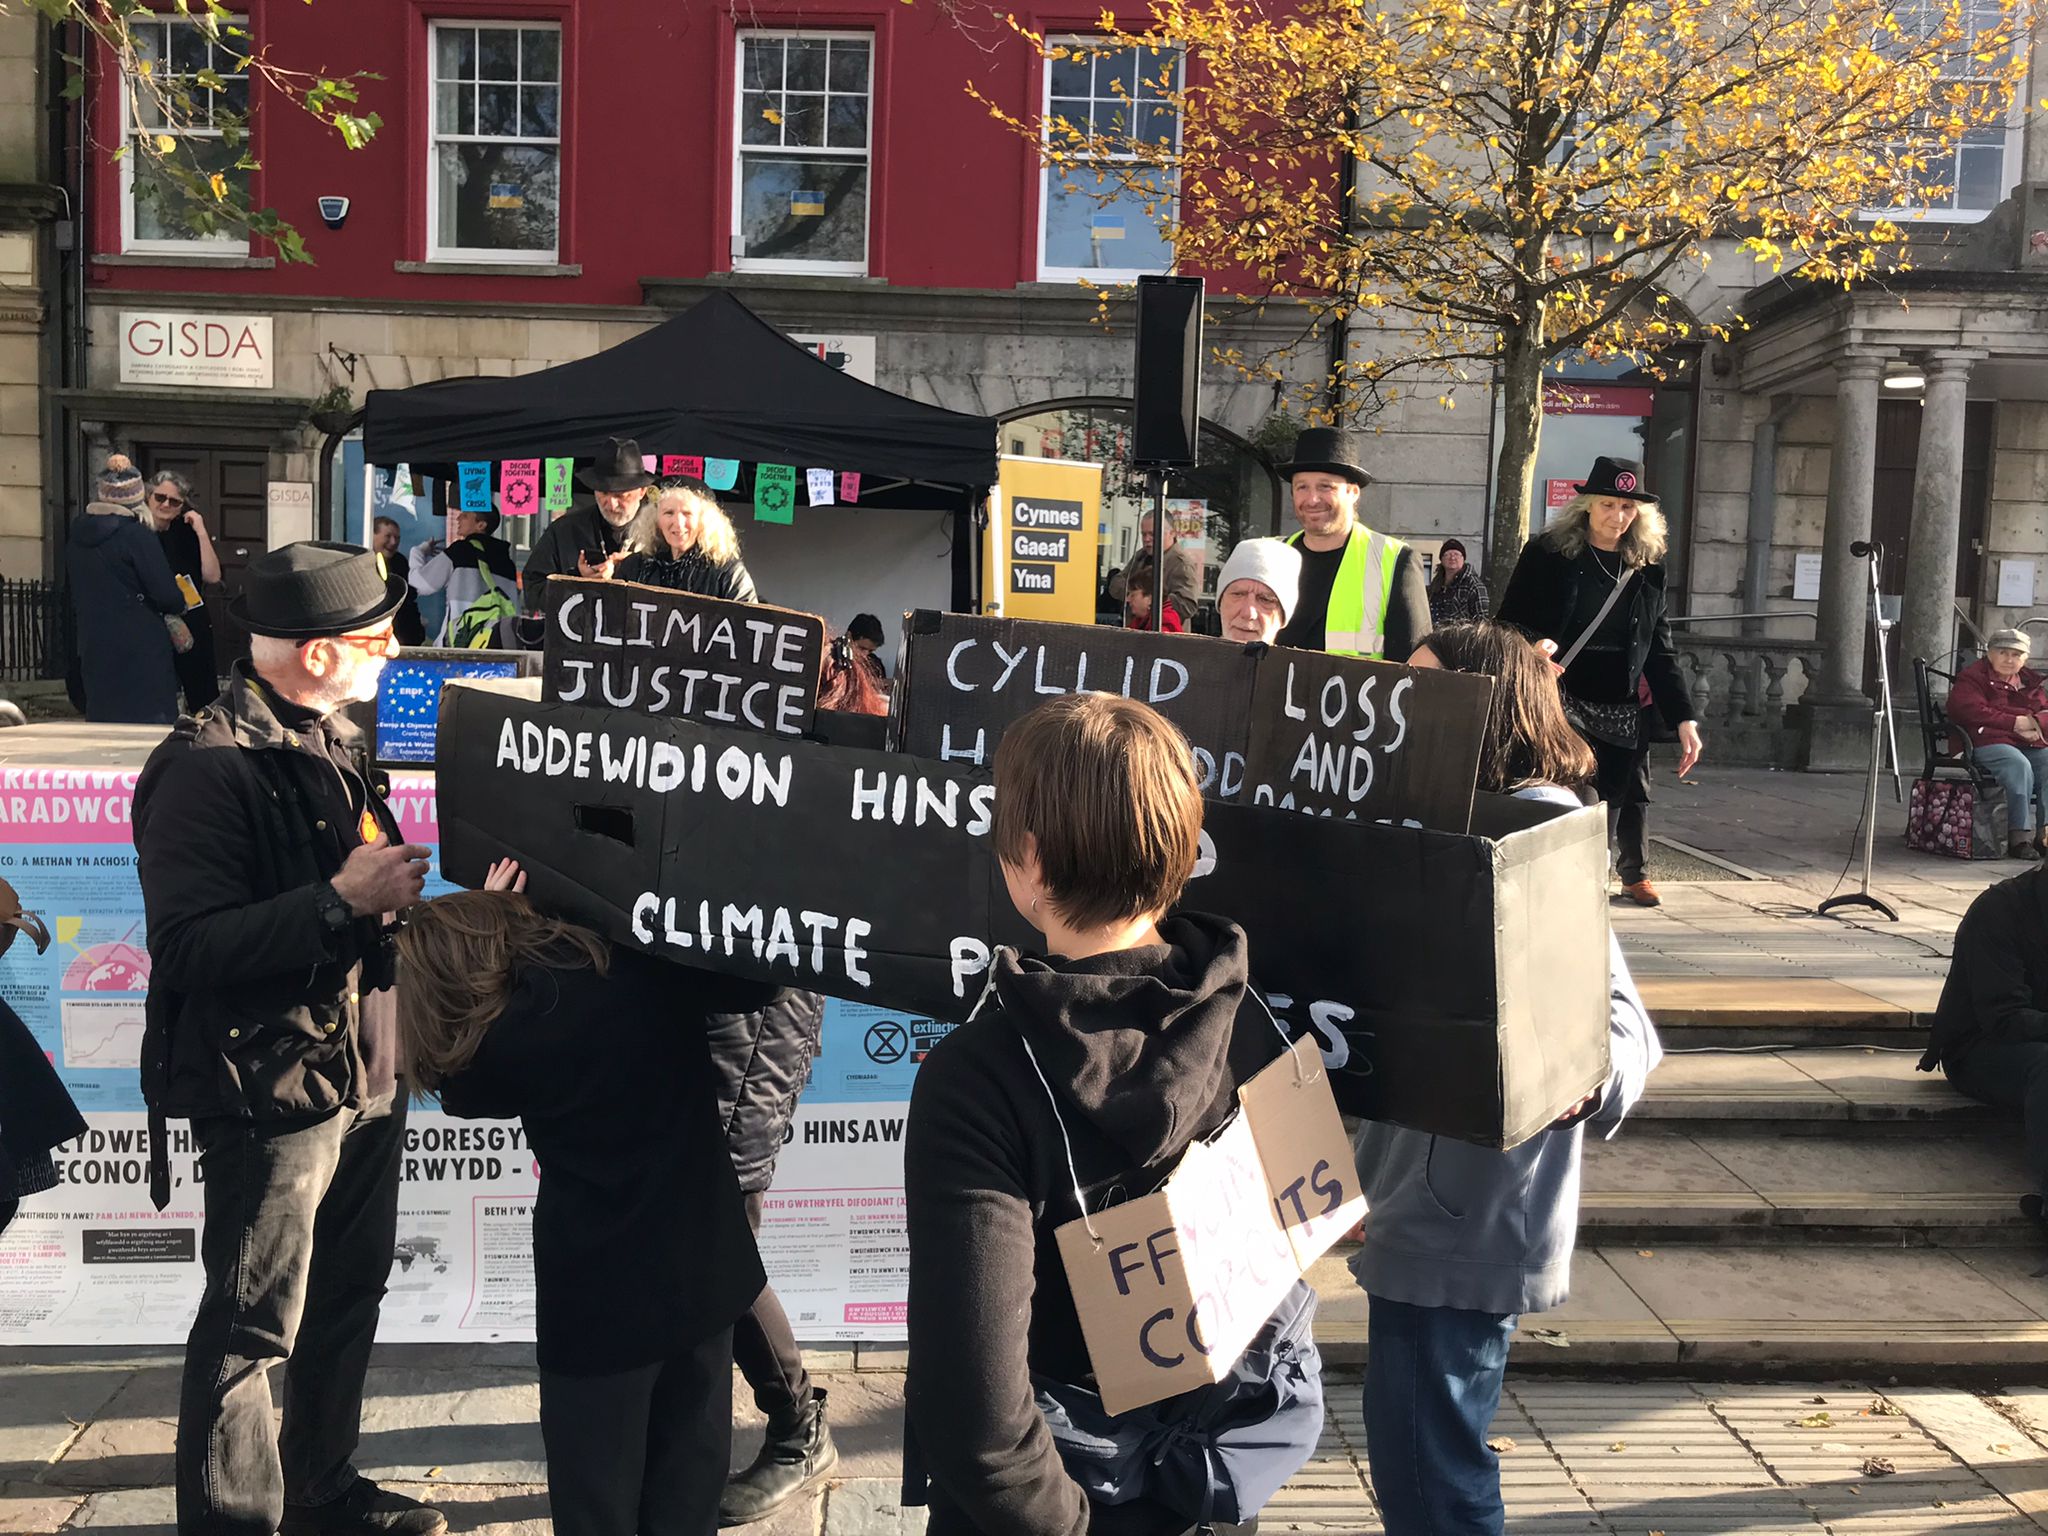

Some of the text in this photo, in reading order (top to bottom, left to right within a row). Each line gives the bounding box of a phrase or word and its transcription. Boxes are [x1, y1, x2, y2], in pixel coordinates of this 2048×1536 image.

[128, 320, 262, 359] GISDA
[464, 467, 487, 475] LIVING
[761, 473, 792, 481] TOGETHER
[269, 490, 310, 501] GISDA
[1015, 502, 1080, 526] Cynnes
[1014, 536, 1066, 557] Gaeaf
[1014, 568, 1051, 588] Yma
[558, 593, 808, 674] CLIMATE
[947, 639, 1189, 703] CYLLID
[559, 660, 806, 734] JUSTICE
[1284, 662, 1412, 752] LOSS
[497, 717, 792, 807] ADDEWIDION
[1290, 732, 1374, 802] AND
[22, 856, 29, 866] A
[32, 857, 72, 866] METHAN
[76, 857, 90, 866] YN
[93, 857, 130, 866] ACHOSI
[632, 891, 871, 986] CLIMATE
[402, 1127, 532, 1152] GORESGY
[804, 1119, 904, 1144] HINSAW
[484, 1206, 507, 1216] BETH
[788, 1199, 845, 1209] GWRTHRYFEL
[846, 1198, 894, 1208] DIFODIANT
[73, 1212, 94, 1220] AWR?
